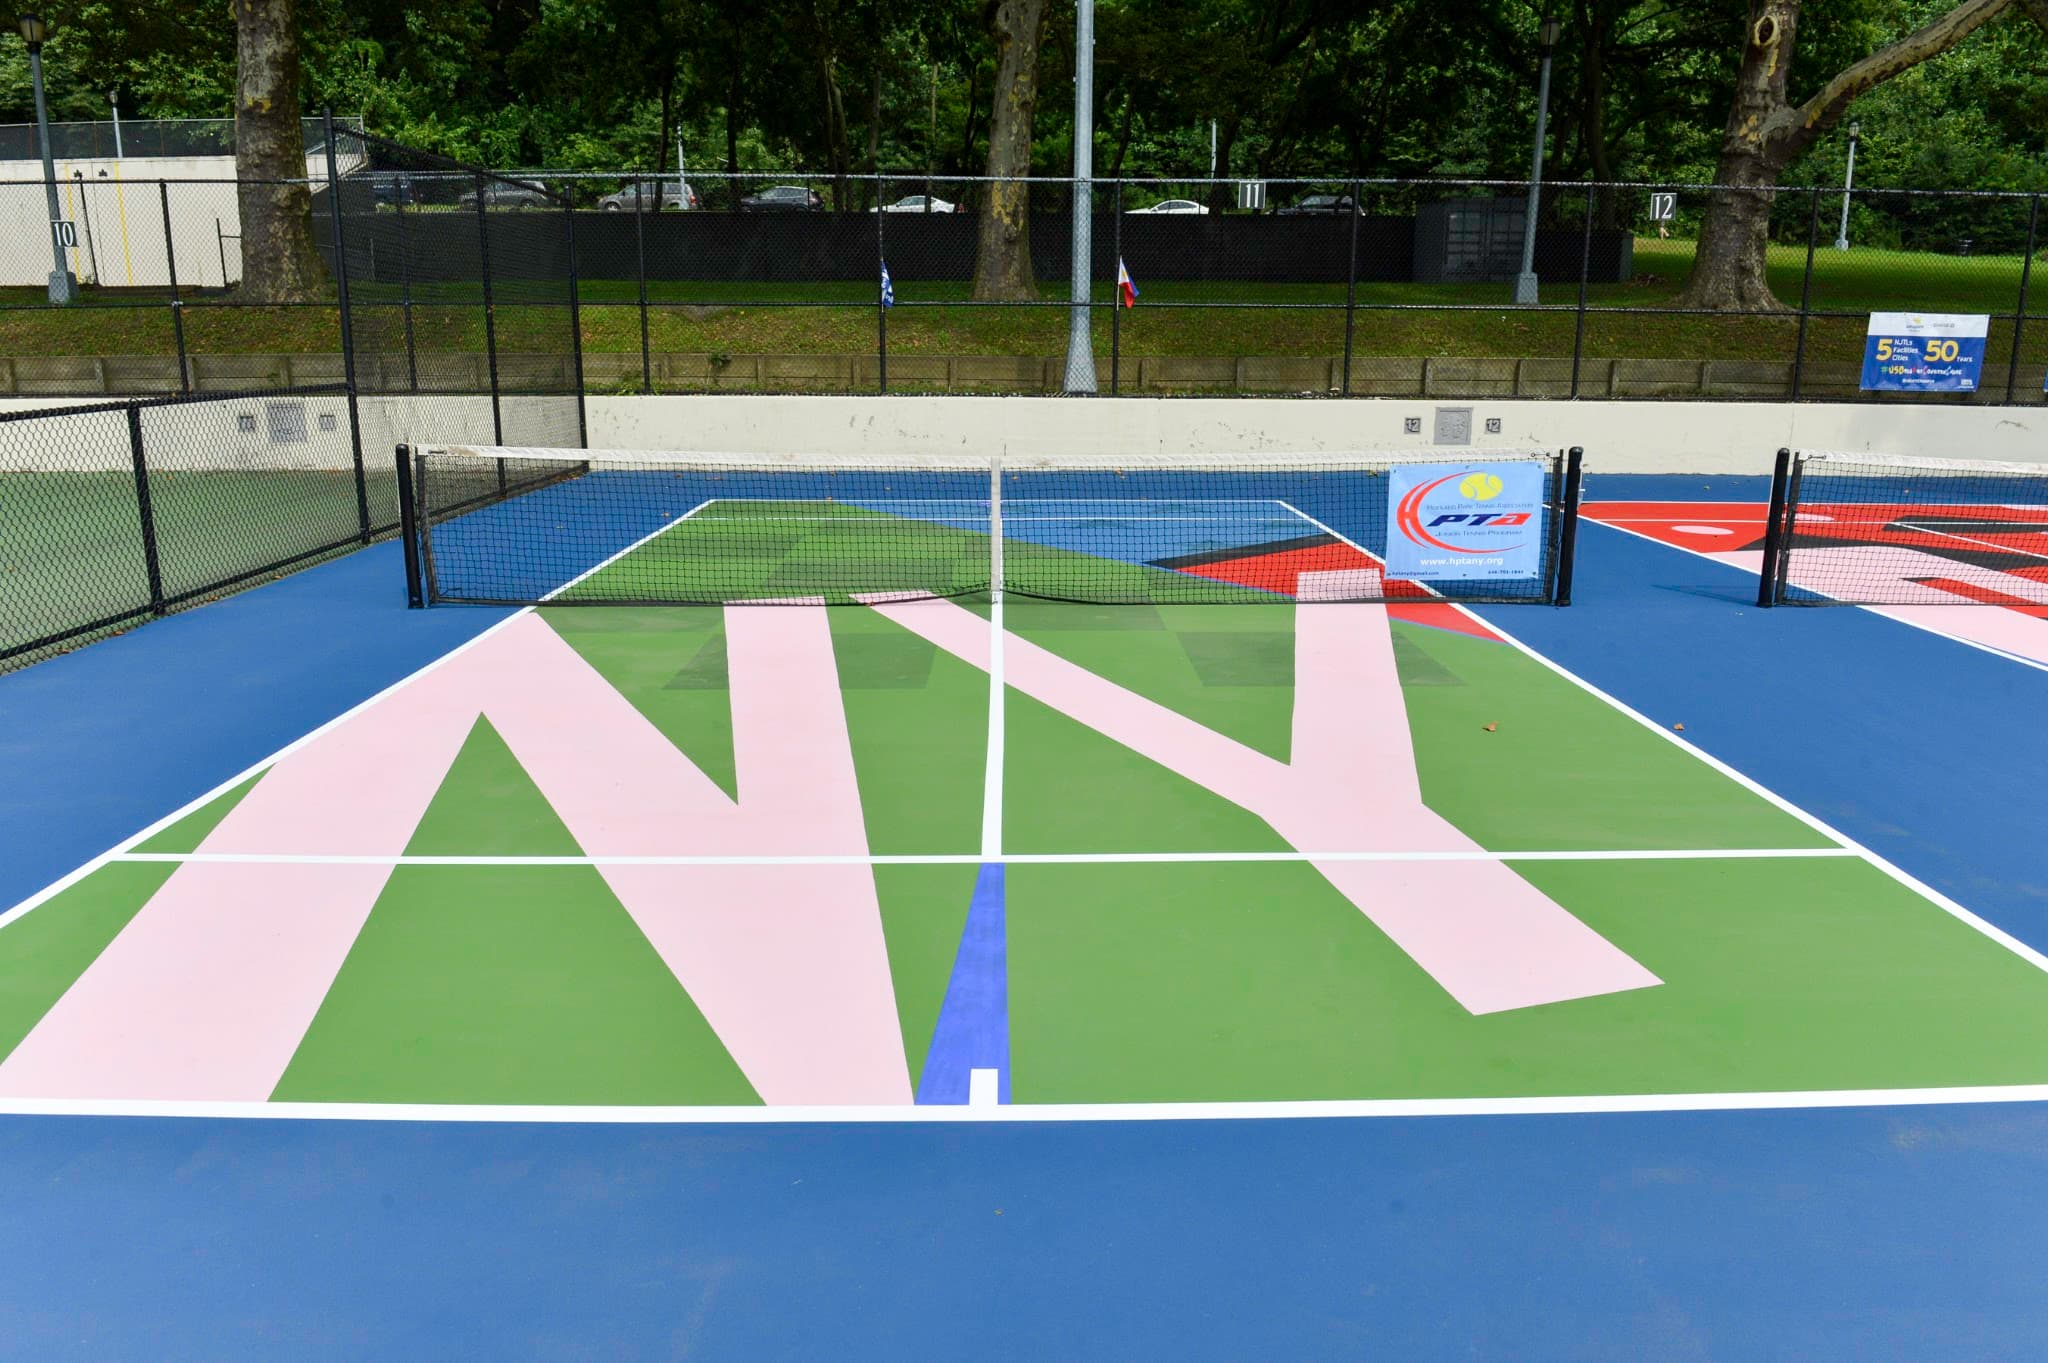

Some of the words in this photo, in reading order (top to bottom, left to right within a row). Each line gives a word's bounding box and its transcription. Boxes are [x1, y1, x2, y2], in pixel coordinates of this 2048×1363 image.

[1246, 184, 1259, 208] 11
[1655, 196, 1673, 219] 12
[54, 223, 74, 246] 10
[1876, 339, 1893, 361] 5
[1924, 340, 1959, 362] 50
[1406, 419, 1420, 432] 12
[1486, 419, 1500, 432] 12
[1420, 557, 1504, 567] www.hptany.org
